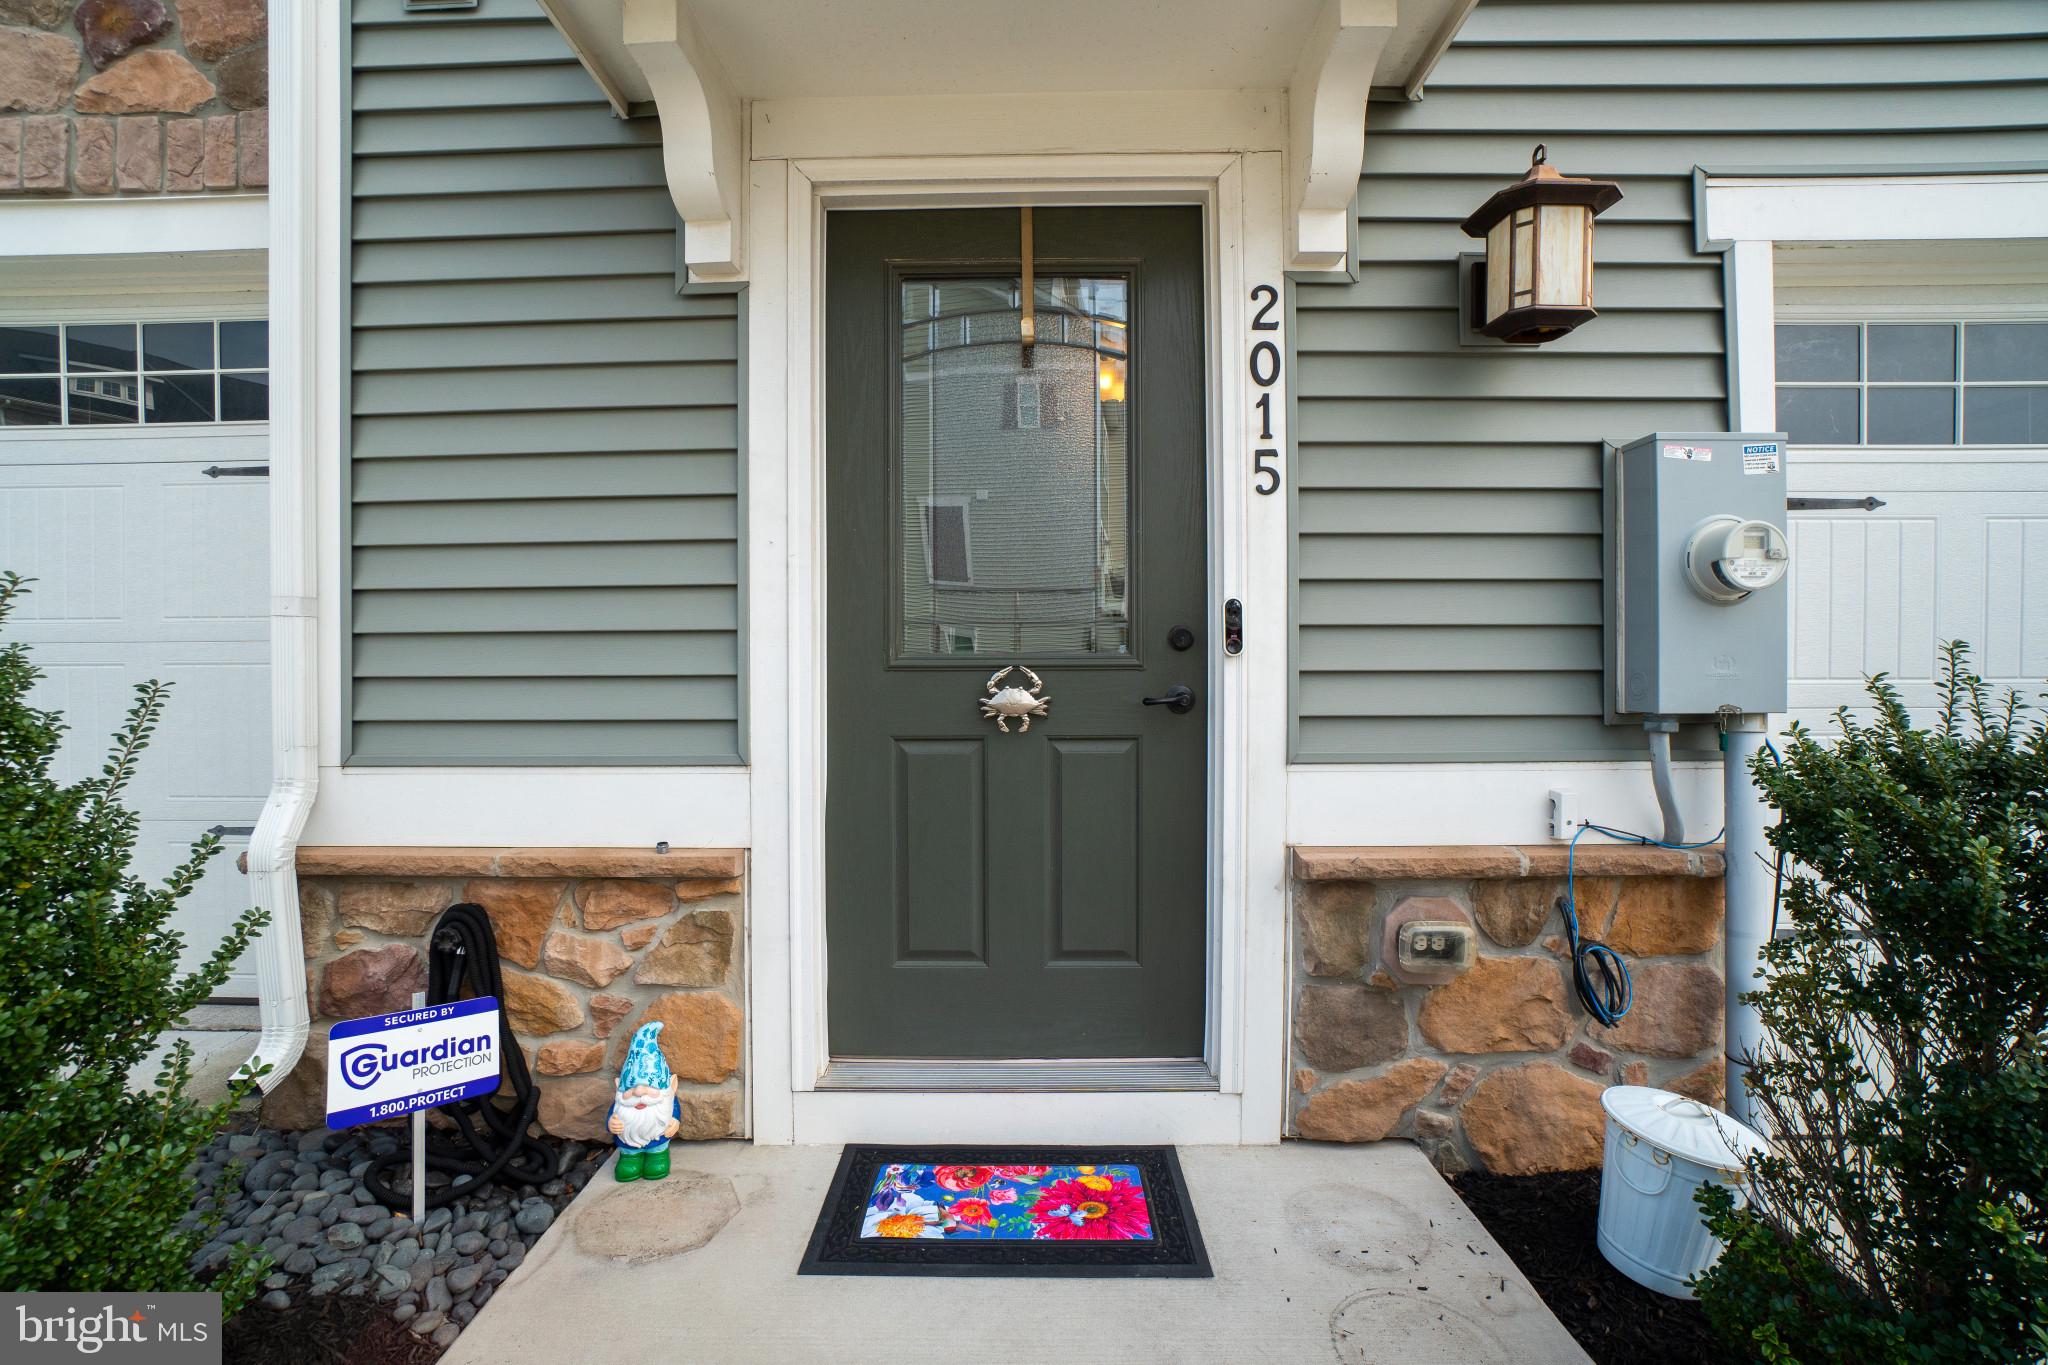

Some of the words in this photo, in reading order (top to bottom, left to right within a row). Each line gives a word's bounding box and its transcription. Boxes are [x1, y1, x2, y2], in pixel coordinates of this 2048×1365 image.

[1250, 284, 1281, 496] 2015
[1746, 445, 1775, 454] NOTICE
[384, 1010, 438, 1027] SECURED
[441, 1006, 455, 1016] BY
[351, 1034, 491, 1078] Guardian
[412, 1052, 492, 1080] PROTECTION
[369, 1085, 466, 1118] 1.800.PROTECT
